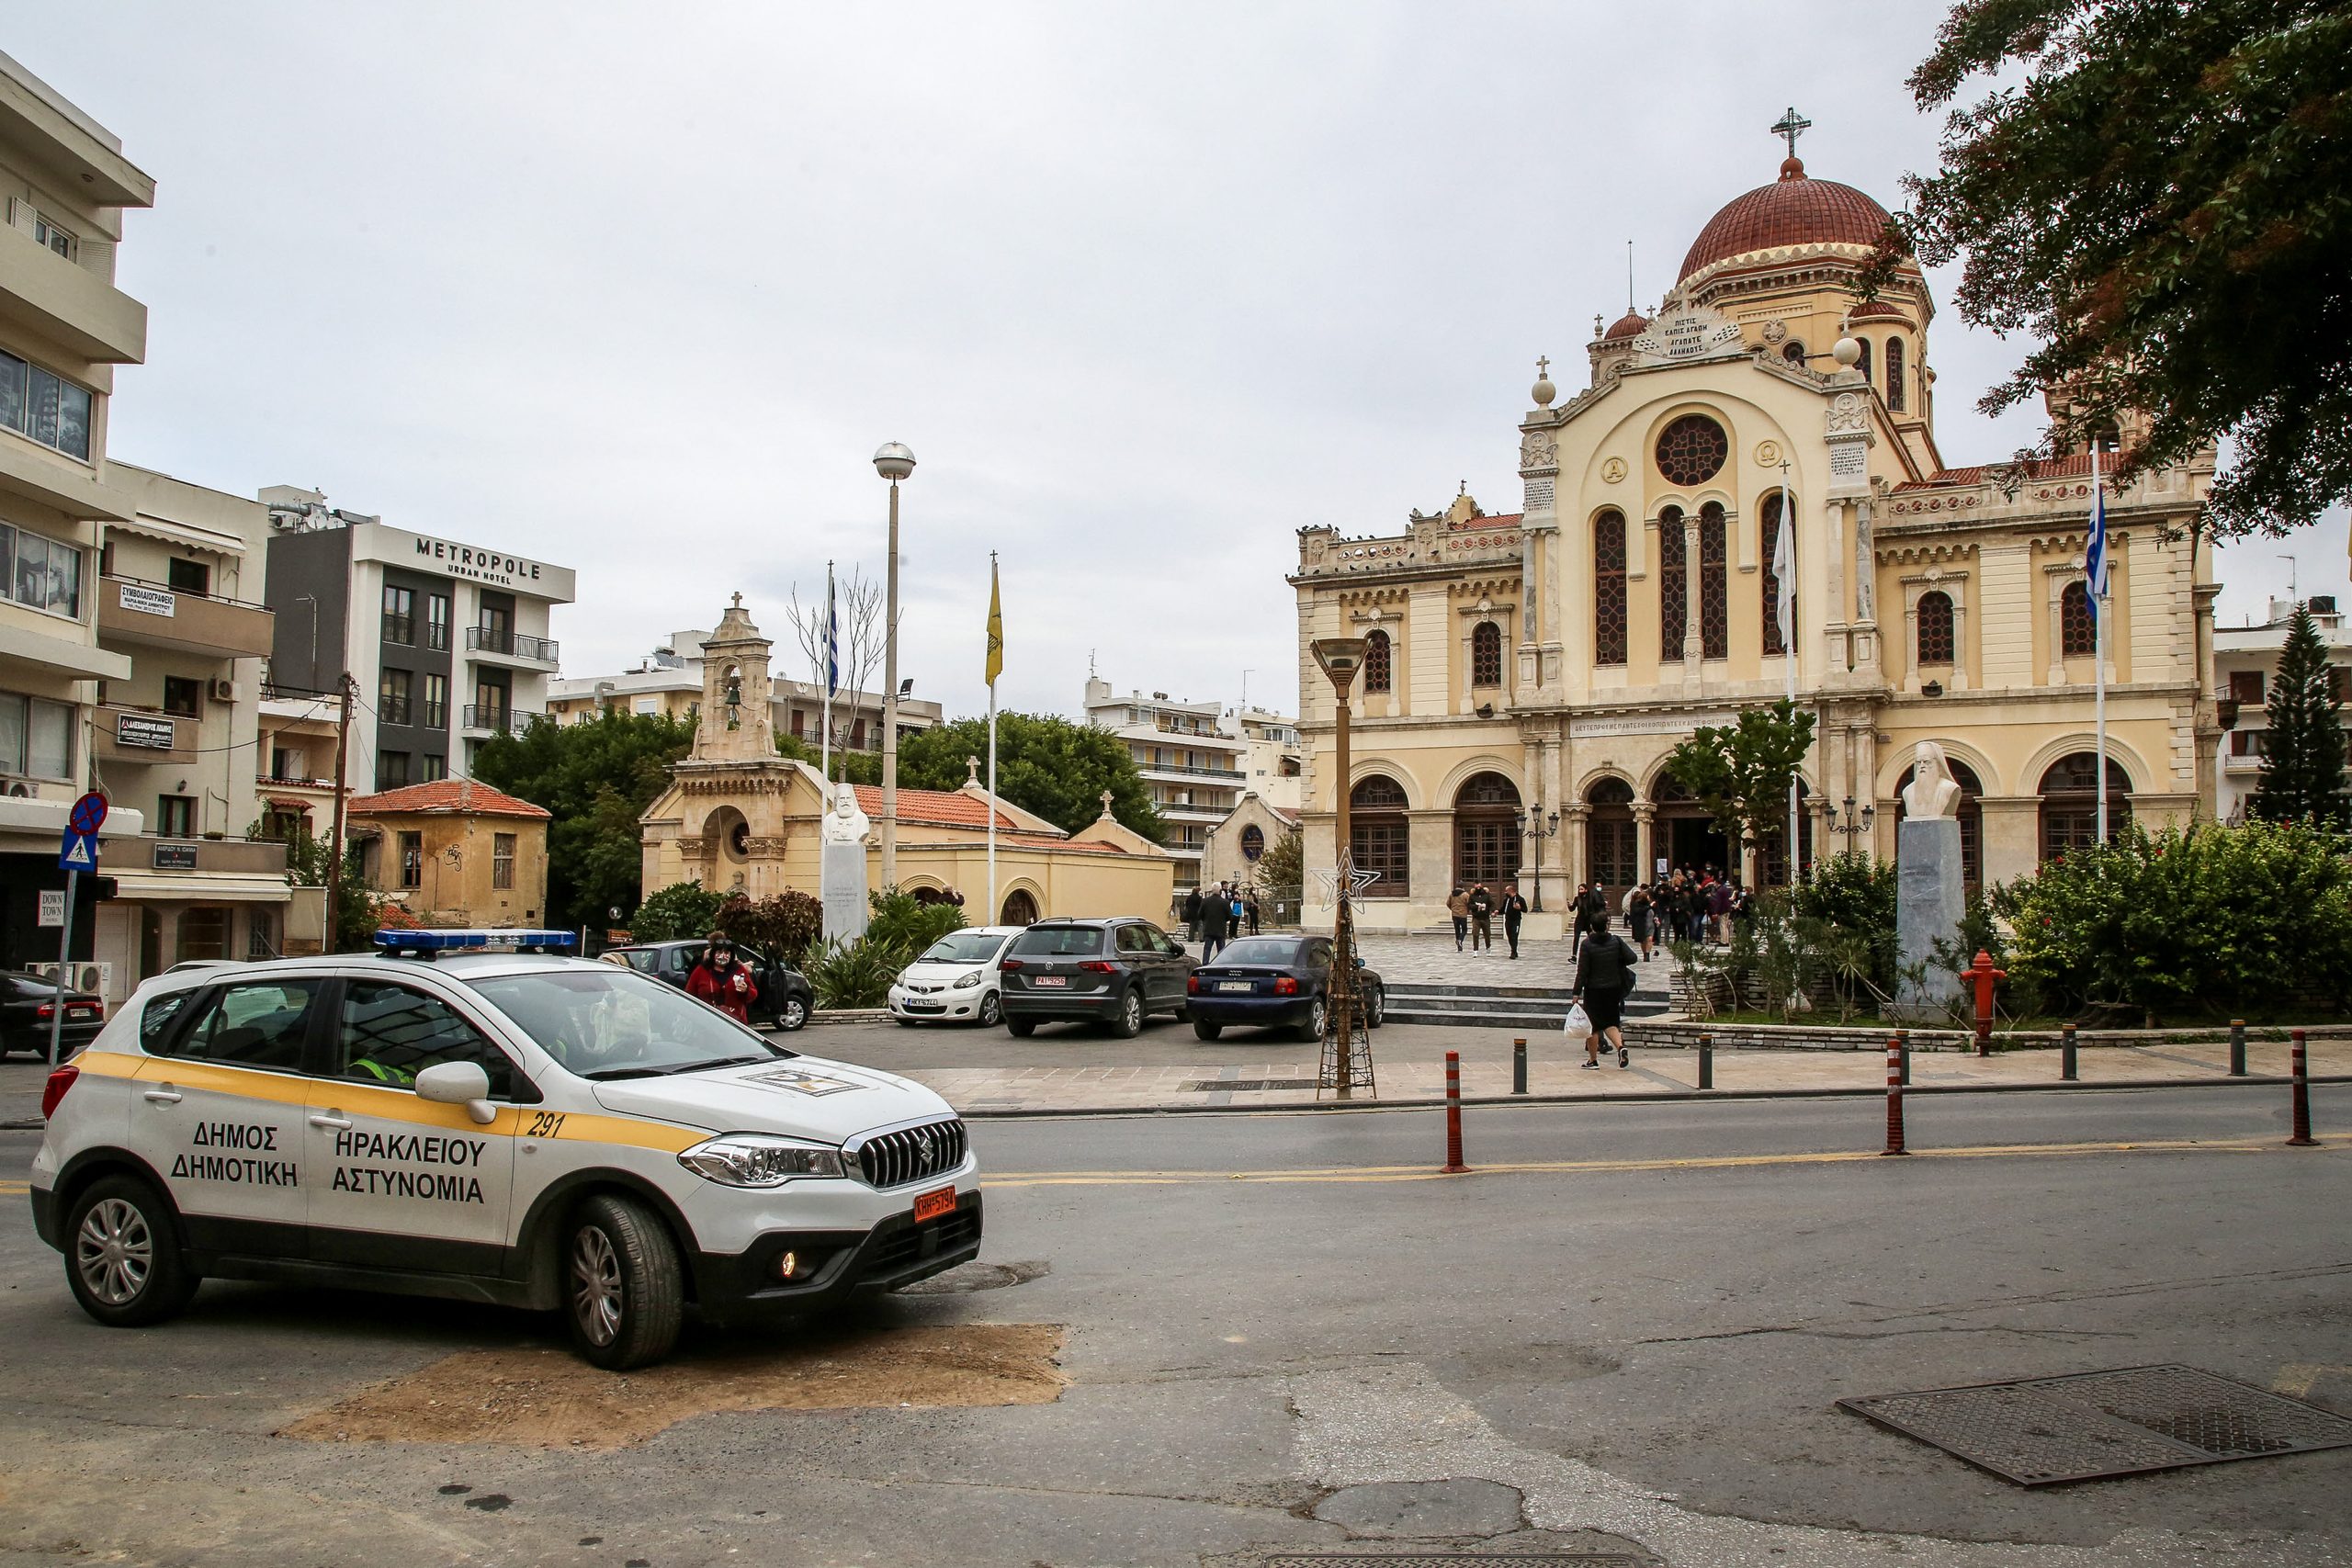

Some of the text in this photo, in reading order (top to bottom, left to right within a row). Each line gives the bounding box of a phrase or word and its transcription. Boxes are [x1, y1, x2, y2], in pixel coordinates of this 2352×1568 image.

[1665, 324, 1707, 336] ΕΛΠΙΣ ΑΓΑΠΗ
[1675, 318, 1697, 326] ΠΙΣΤΙΣ
[1670, 335, 1702, 345] ΑΓΑΠΑΤΕ
[416, 537, 540, 580] METROPOLE
[447, 564, 512, 585] URBAN HOTEL
[122, 587, 173, 604] ΣΥΜΒΟΛΑΙΟΓΡΑΦΕΙΟ
[42, 894, 63, 905] DOWN
[41, 906, 62, 917] TOWN
[526, 1111, 567, 1138] 291
[193, 1122, 487, 1168] ΔΗΜΟΣ ΗΡΑΚΛΕΙΟΥ
[170, 1154, 485, 1204] ΔΗΜΟΤΙΚΗ ΑΣΤΥΝΟΜΙΑ
